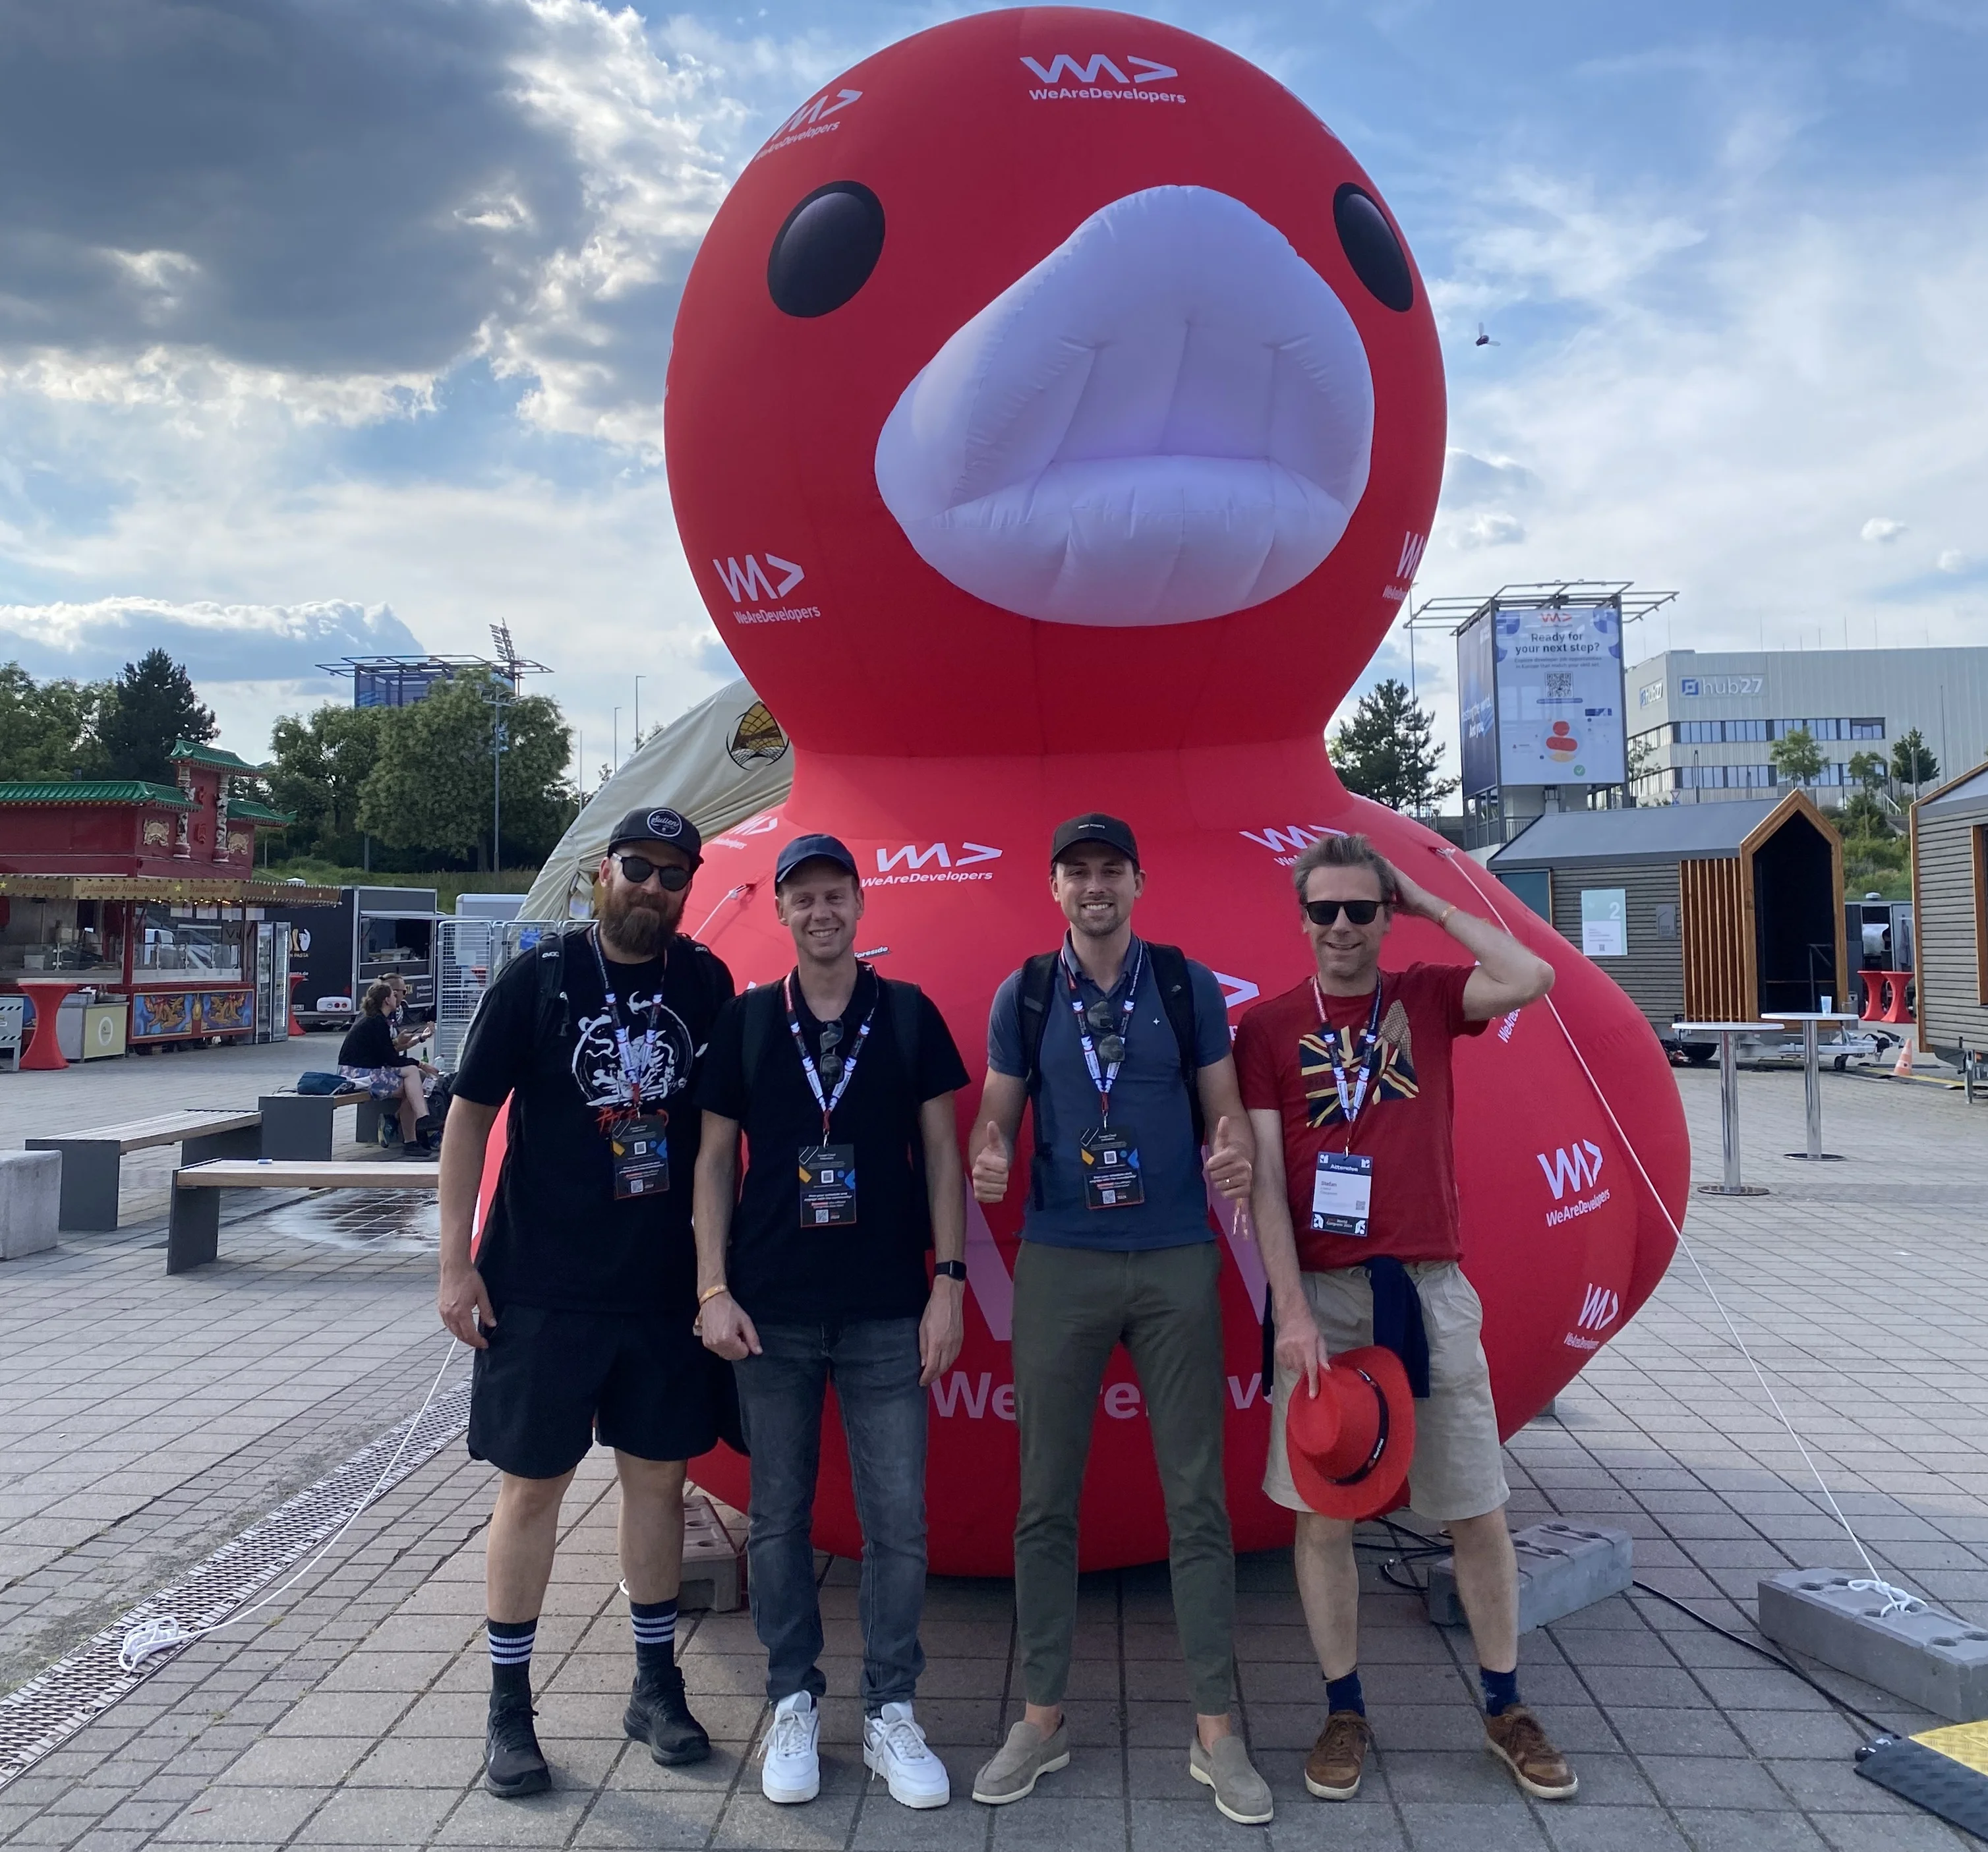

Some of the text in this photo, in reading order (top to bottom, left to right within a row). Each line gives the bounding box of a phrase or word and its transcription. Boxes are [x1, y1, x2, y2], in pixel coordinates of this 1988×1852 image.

[1029, 87, 1186, 103] WeAreDevelopers
[733, 606, 821, 624] WeAreDevelopers
[1531, 631, 1583, 643] Ready for
[1516, 643, 1600, 655] your next step?
[1645, 682, 1663, 705] hub27
[1702, 676, 1763, 695] hub27
[861, 871, 993, 888] WeAreDevelopers
[1610, 902, 1621, 919] 2
[1546, 1188, 1610, 1227] WeAreDevelopers
